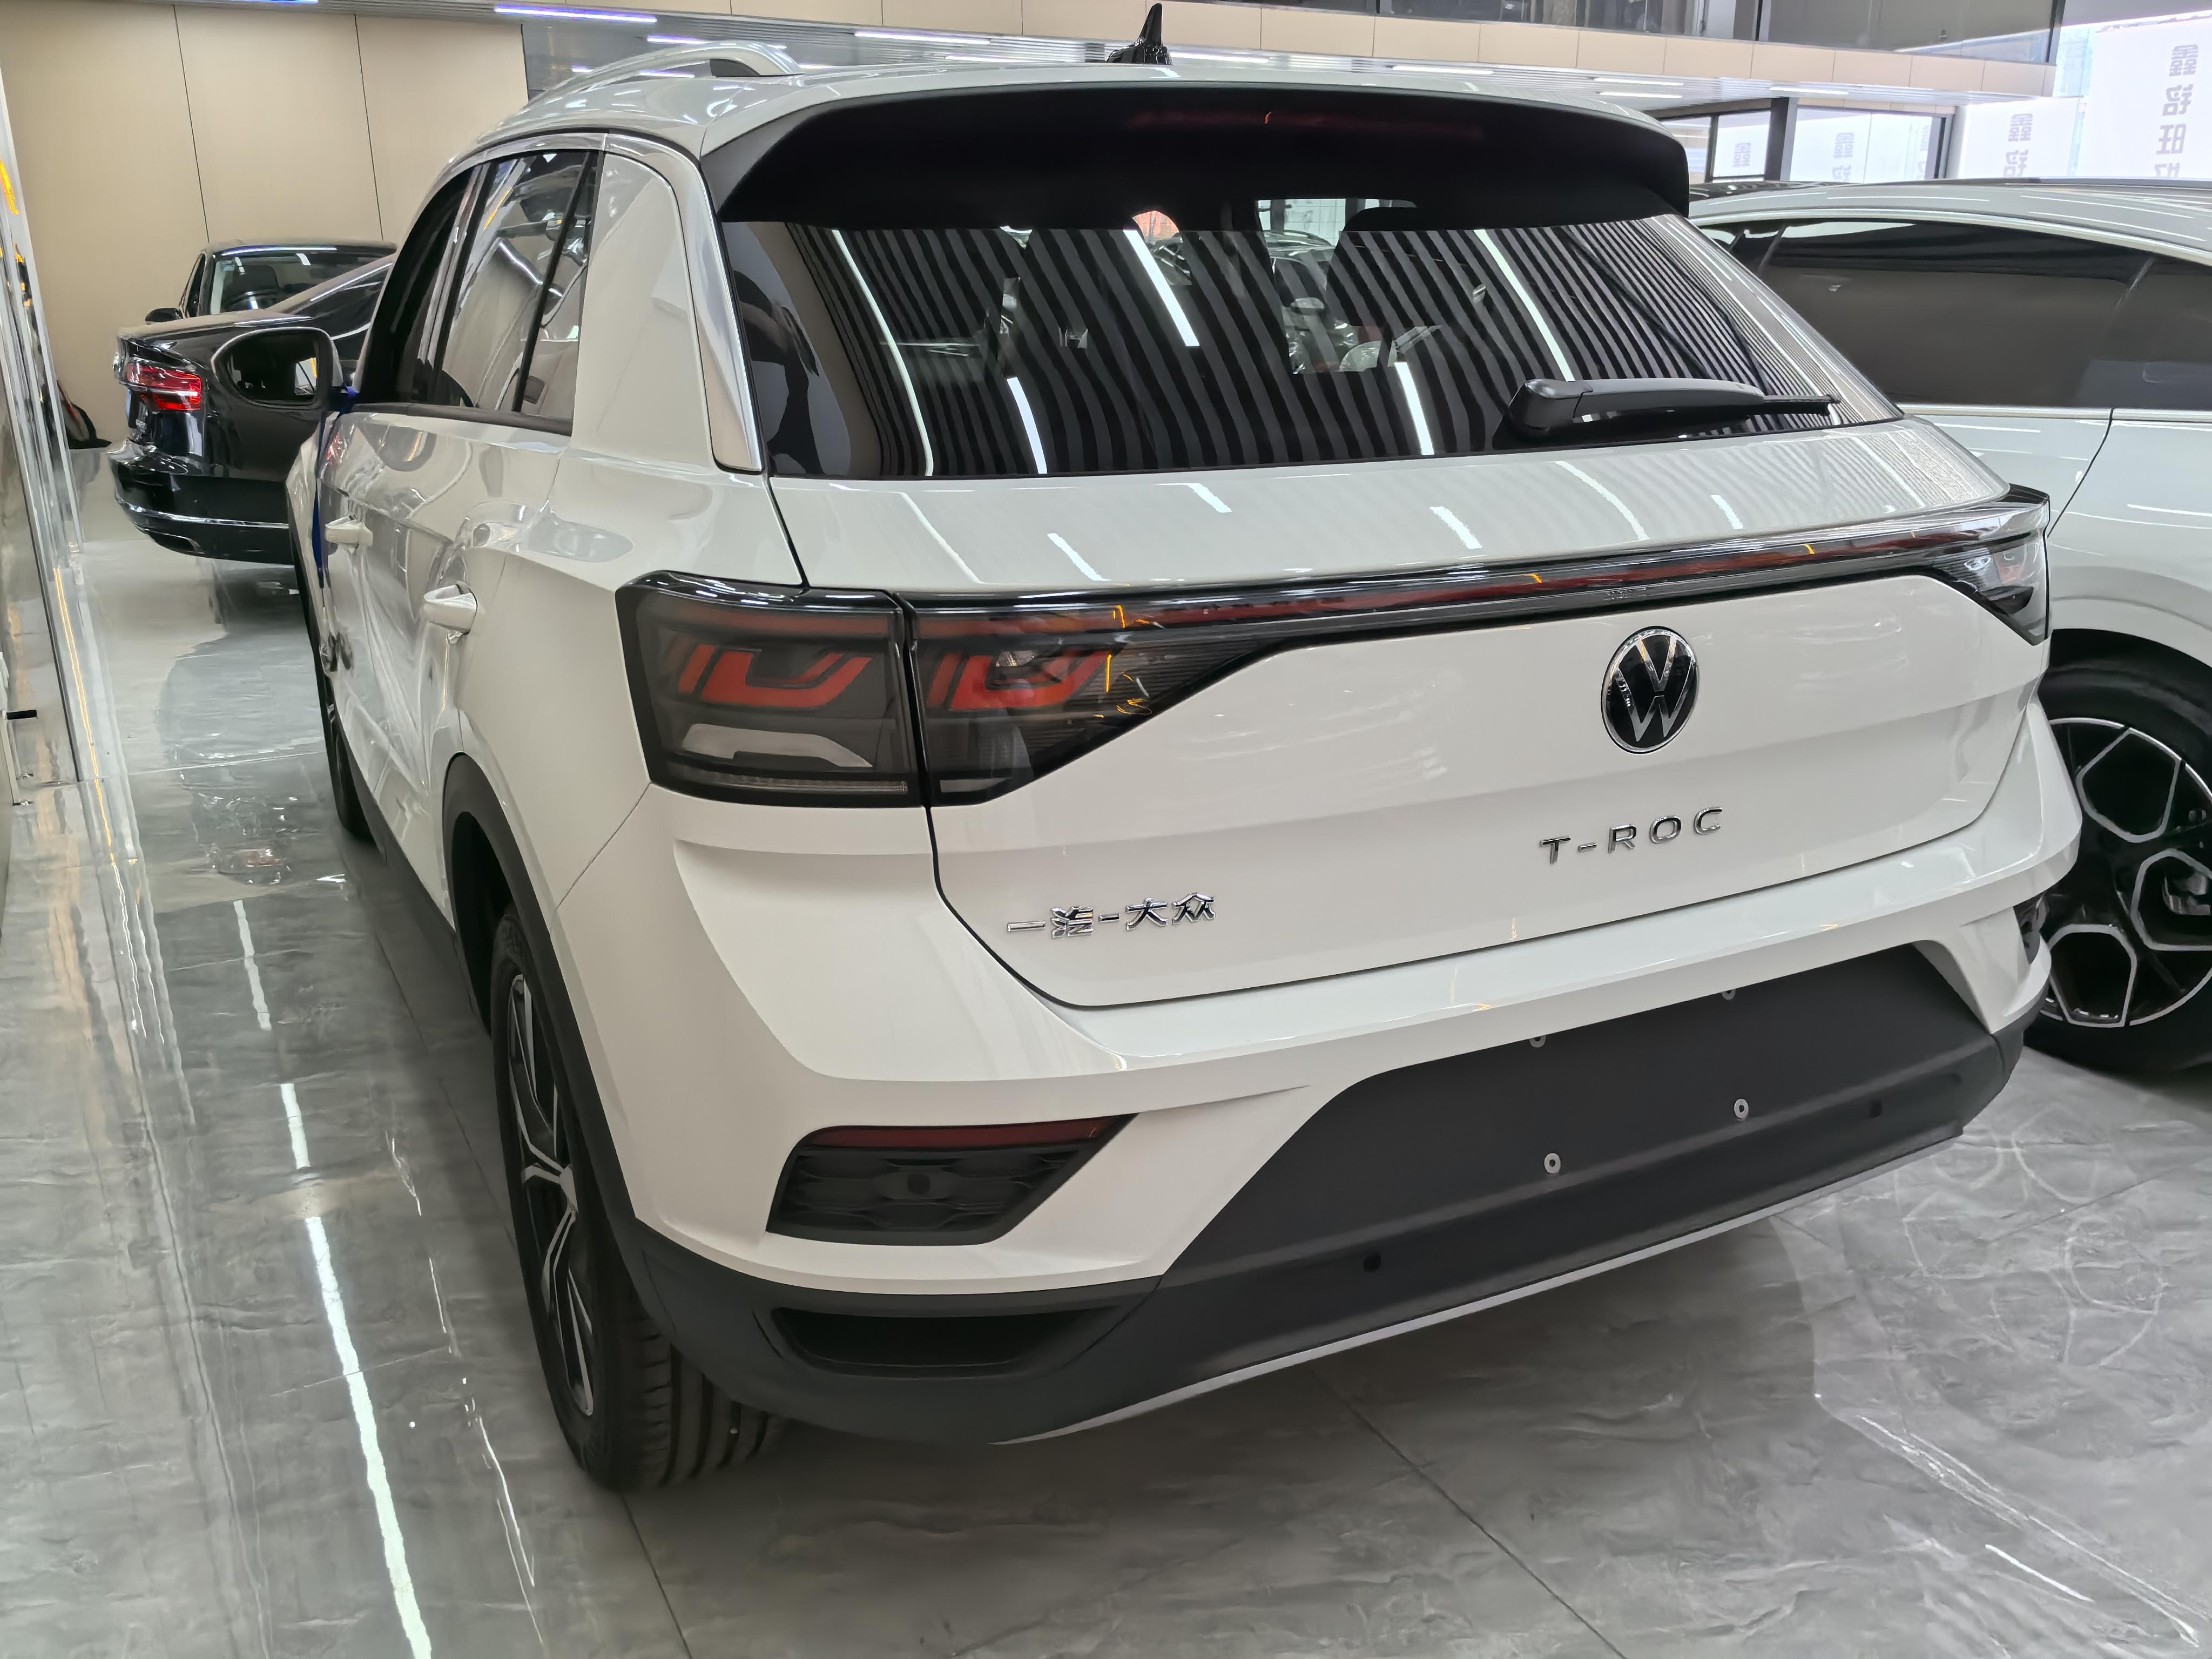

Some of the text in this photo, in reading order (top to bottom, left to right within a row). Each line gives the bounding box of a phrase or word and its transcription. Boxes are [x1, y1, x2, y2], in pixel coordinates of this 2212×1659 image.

[1539, 806, 1723, 865] T-ROC
[1006, 892, 1217, 939] 一汽-大众
